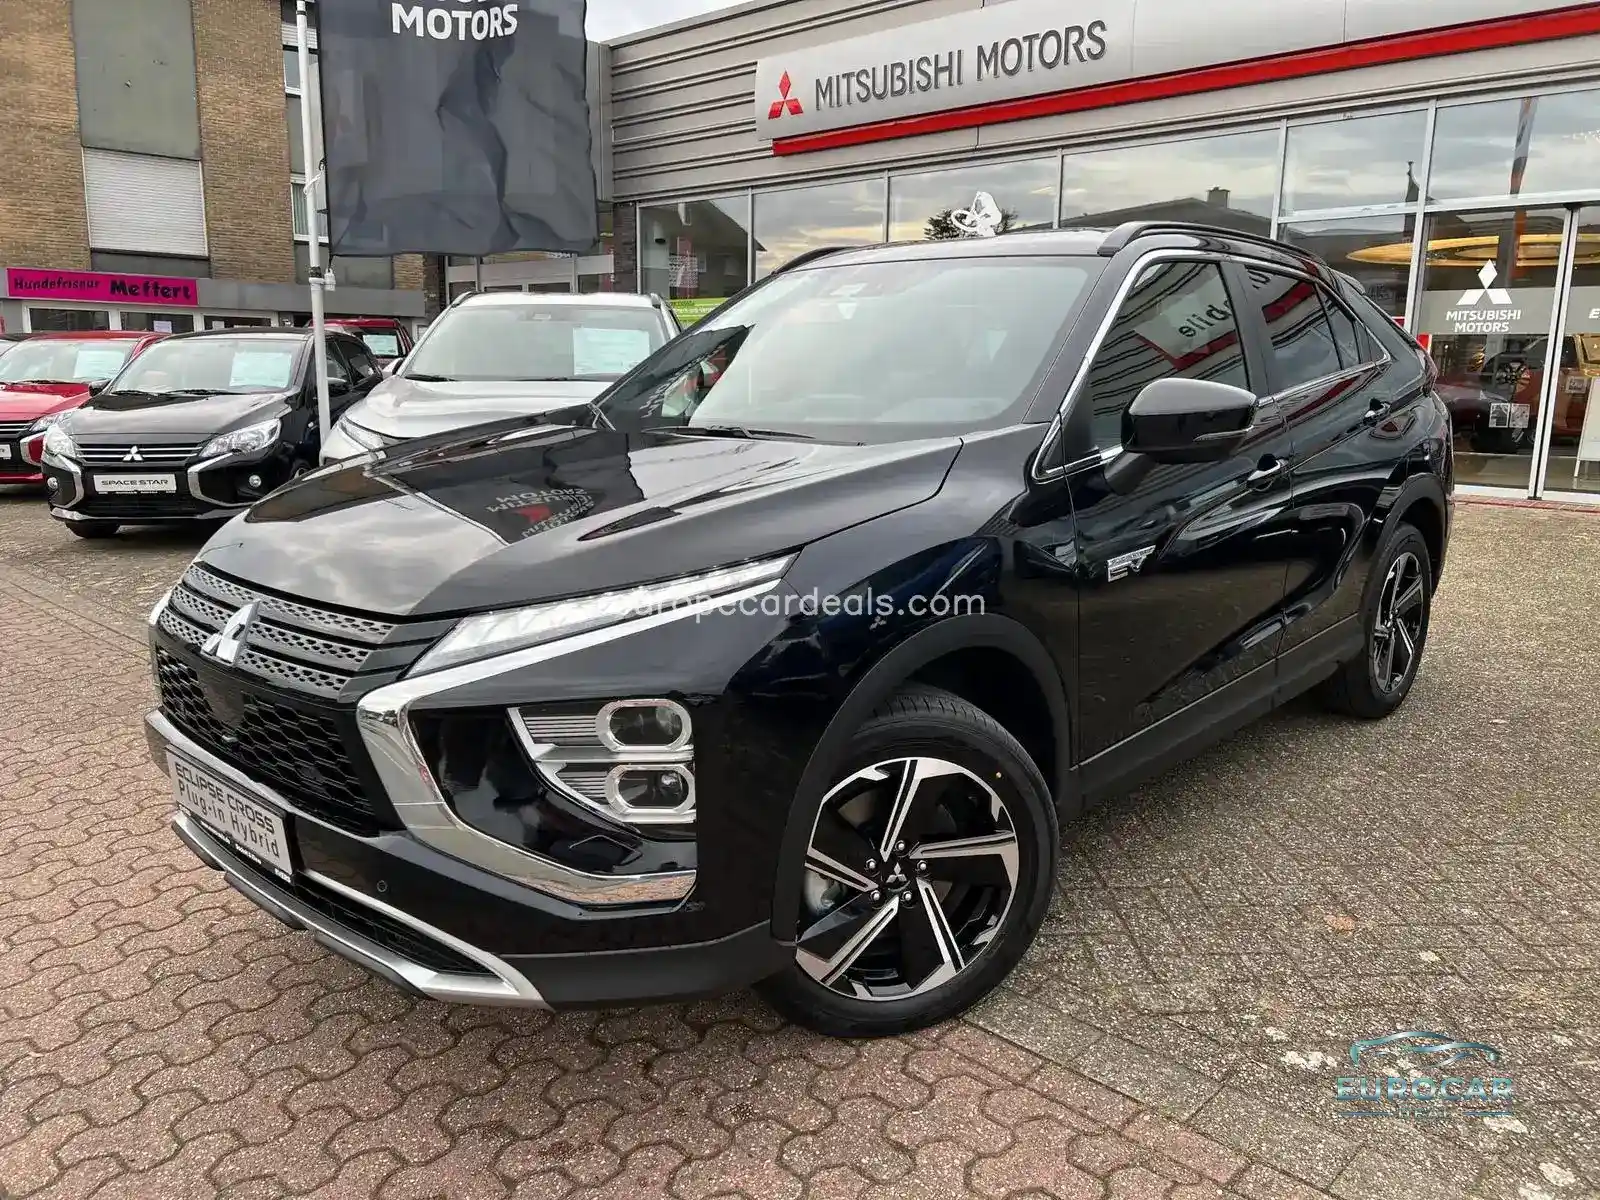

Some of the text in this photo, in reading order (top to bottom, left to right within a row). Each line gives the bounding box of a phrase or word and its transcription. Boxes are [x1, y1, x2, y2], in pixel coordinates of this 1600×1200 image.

[391, 2, 518, 41] MOTORS
[815, 19, 1107, 111] MITSUBISHI MOTORS
[1445, 309, 1522, 322] MITSUBISHI
[1454, 321, 1510, 333] MOTORS
[175, 761, 226, 804] ECLIPSE
[227, 793, 275, 834] CROSS
[178, 780, 226, 823] Plug-in
[231, 812, 280, 859] Hybrid
